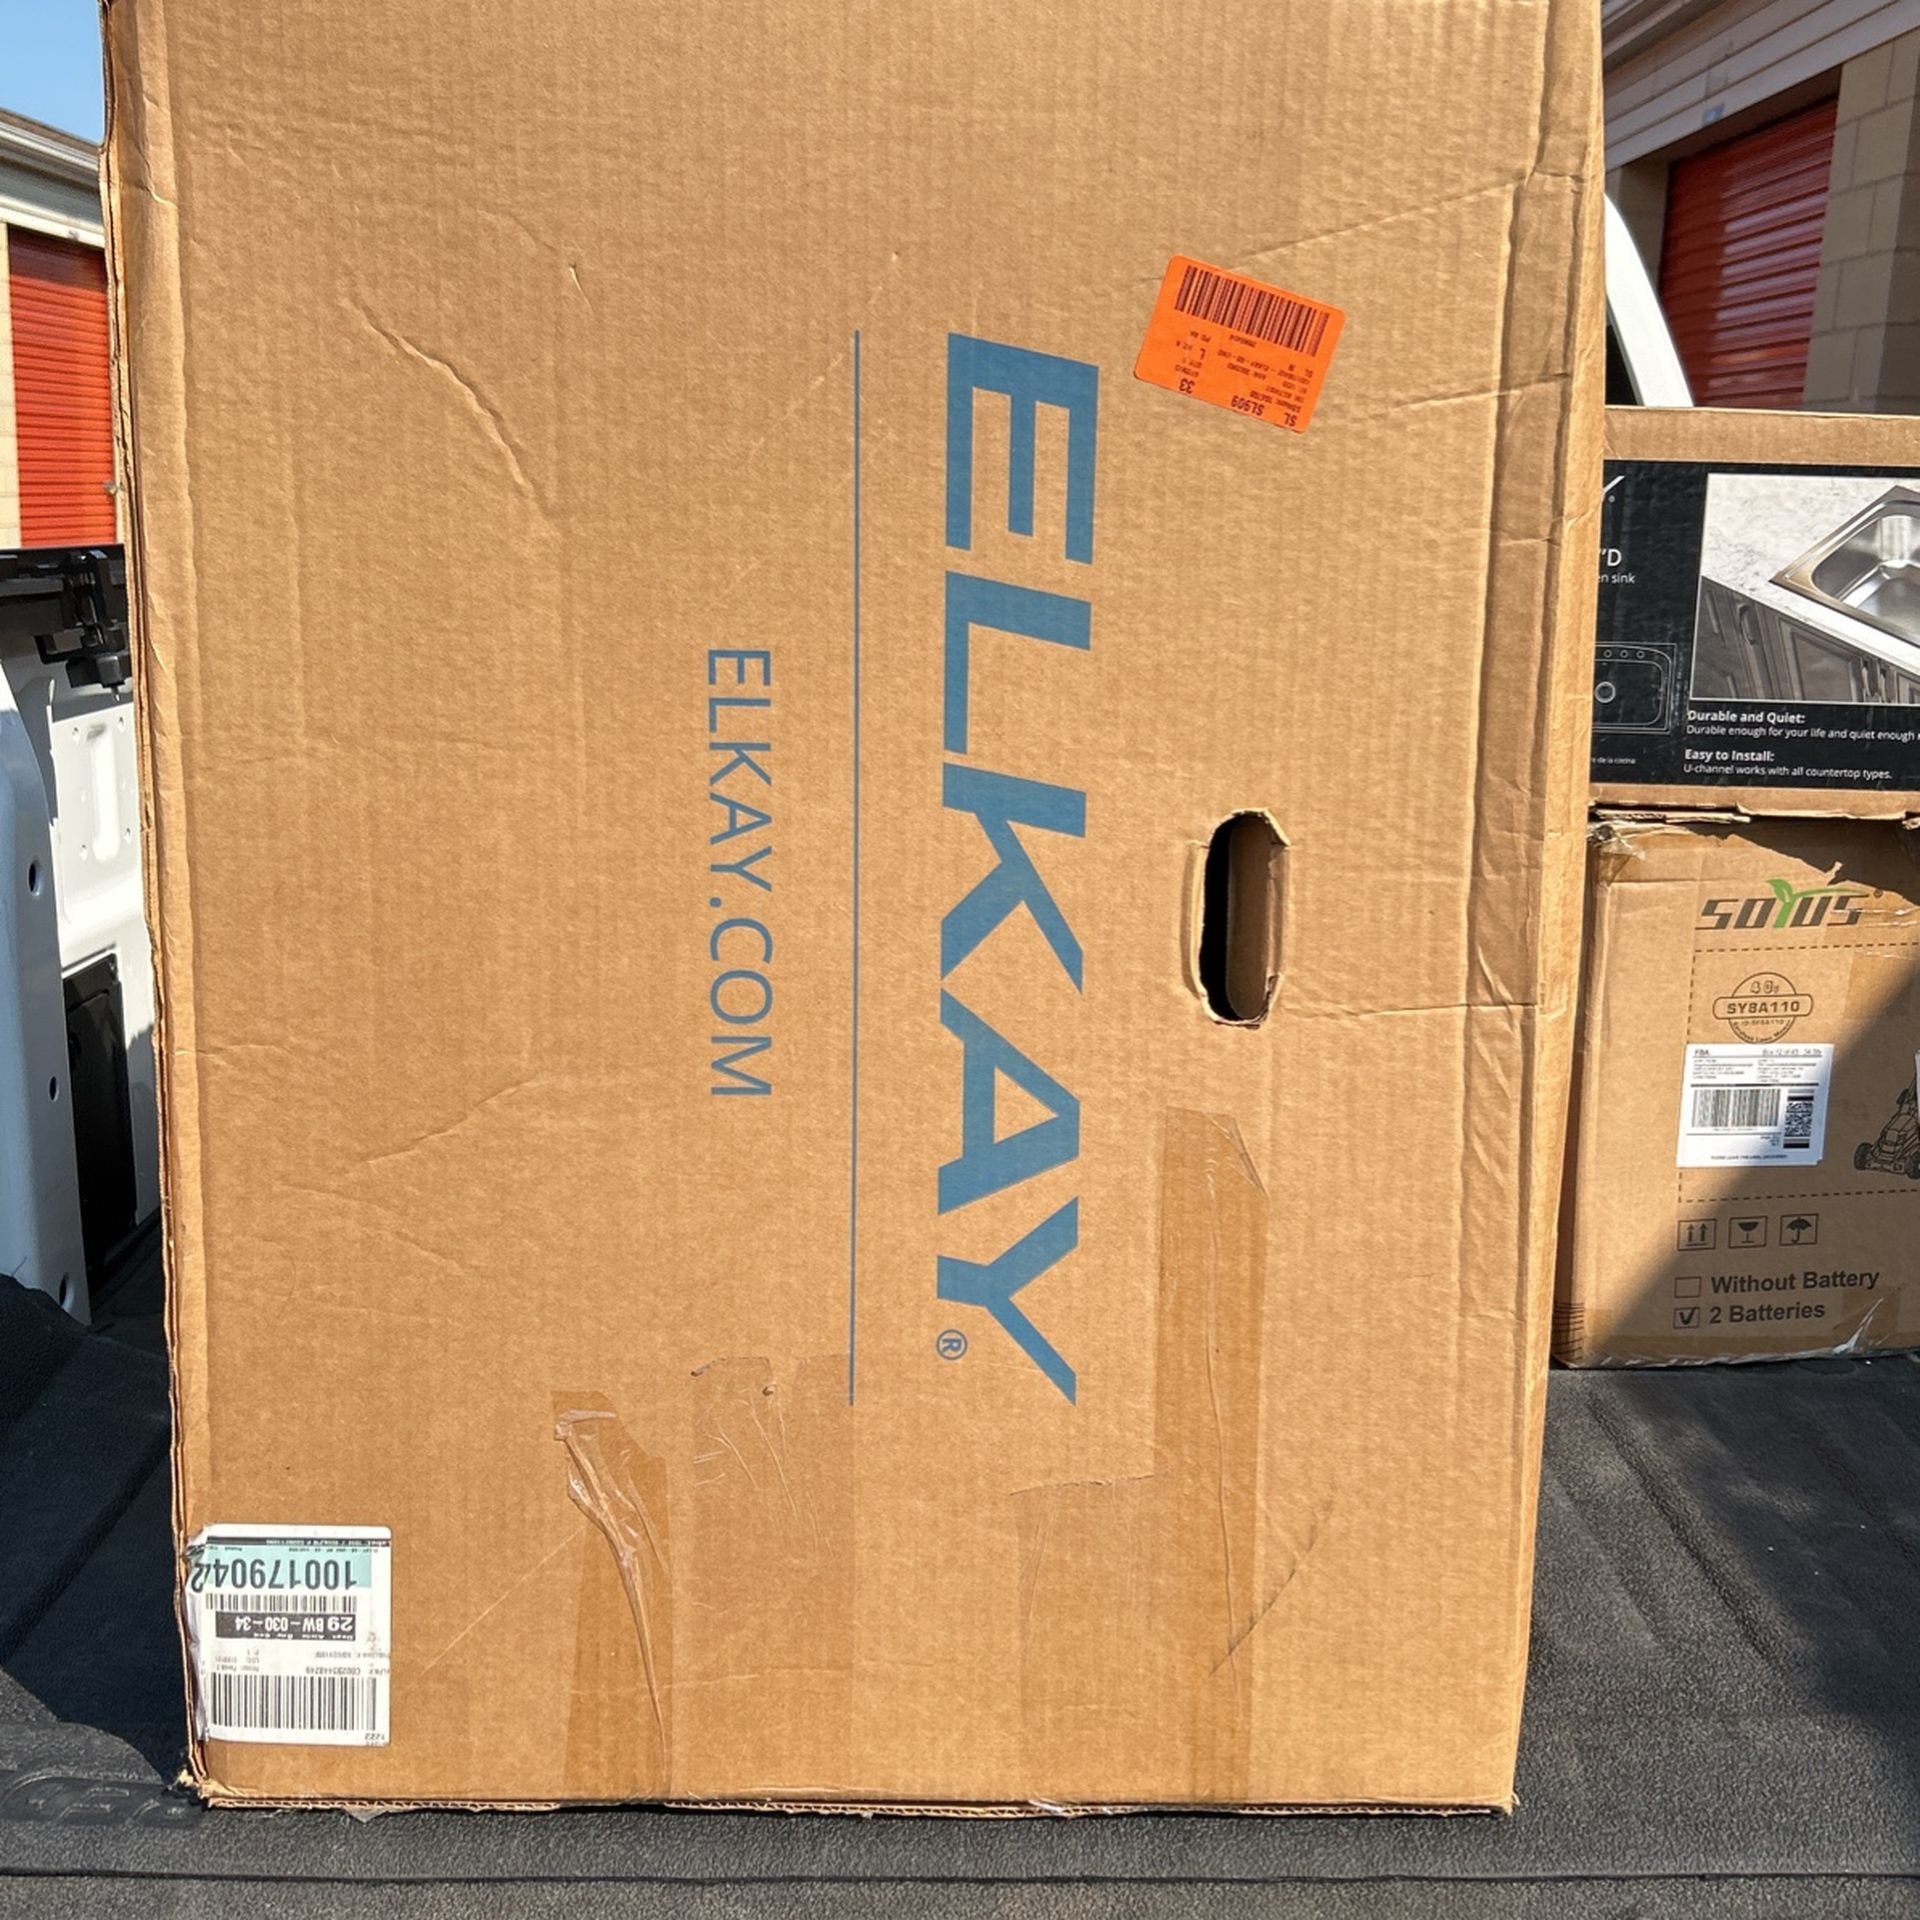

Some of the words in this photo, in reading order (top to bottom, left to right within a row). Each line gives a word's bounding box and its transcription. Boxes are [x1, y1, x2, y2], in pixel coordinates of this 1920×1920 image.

[1178, 378, 1195, 395] 33
[1230, 395, 1265, 417] SL909
[1283, 412, 1298, 427] SL
[1611, 572, 1636, 584] sink
[1687, 710, 1737, 722] Durable
[1740, 712, 1764, 723] and
[1766, 712, 1806, 724] Quiet:
[1687, 724, 1726, 735] Durable
[1728, 726, 1766, 739] enough
[1768, 727, 1784, 738] for
[1784, 728, 1808, 740] your
[1810, 728, 1828, 739] life
[1829, 729, 1847, 739] and
[1849, 730, 1875, 741] quiet
[1877, 731, 1915, 743] enough
[1684, 750, 1713, 763] Easy
[1715, 750, 1730, 761] to
[1731, 750, 1775, 762] Install:
[1684, 763, 1734, 774] U-channel
[1735, 765, 1766, 775] works
[1768, 766, 1789, 776] with
[1791, 766, 1804, 776] all
[1805, 767, 1861, 780] countertop
[1862, 769, 1893, 780] types.
[708, 649, 773, 1096] ELKAY.COM
[1711, 1273, 1796, 1294] Without
[1803, 1270, 1880, 1290] Battery
[1709, 1306, 1722, 1324] 2
[1729, 1302, 1826, 1323] Batteries
[328, 1616, 353, 1631] 29
